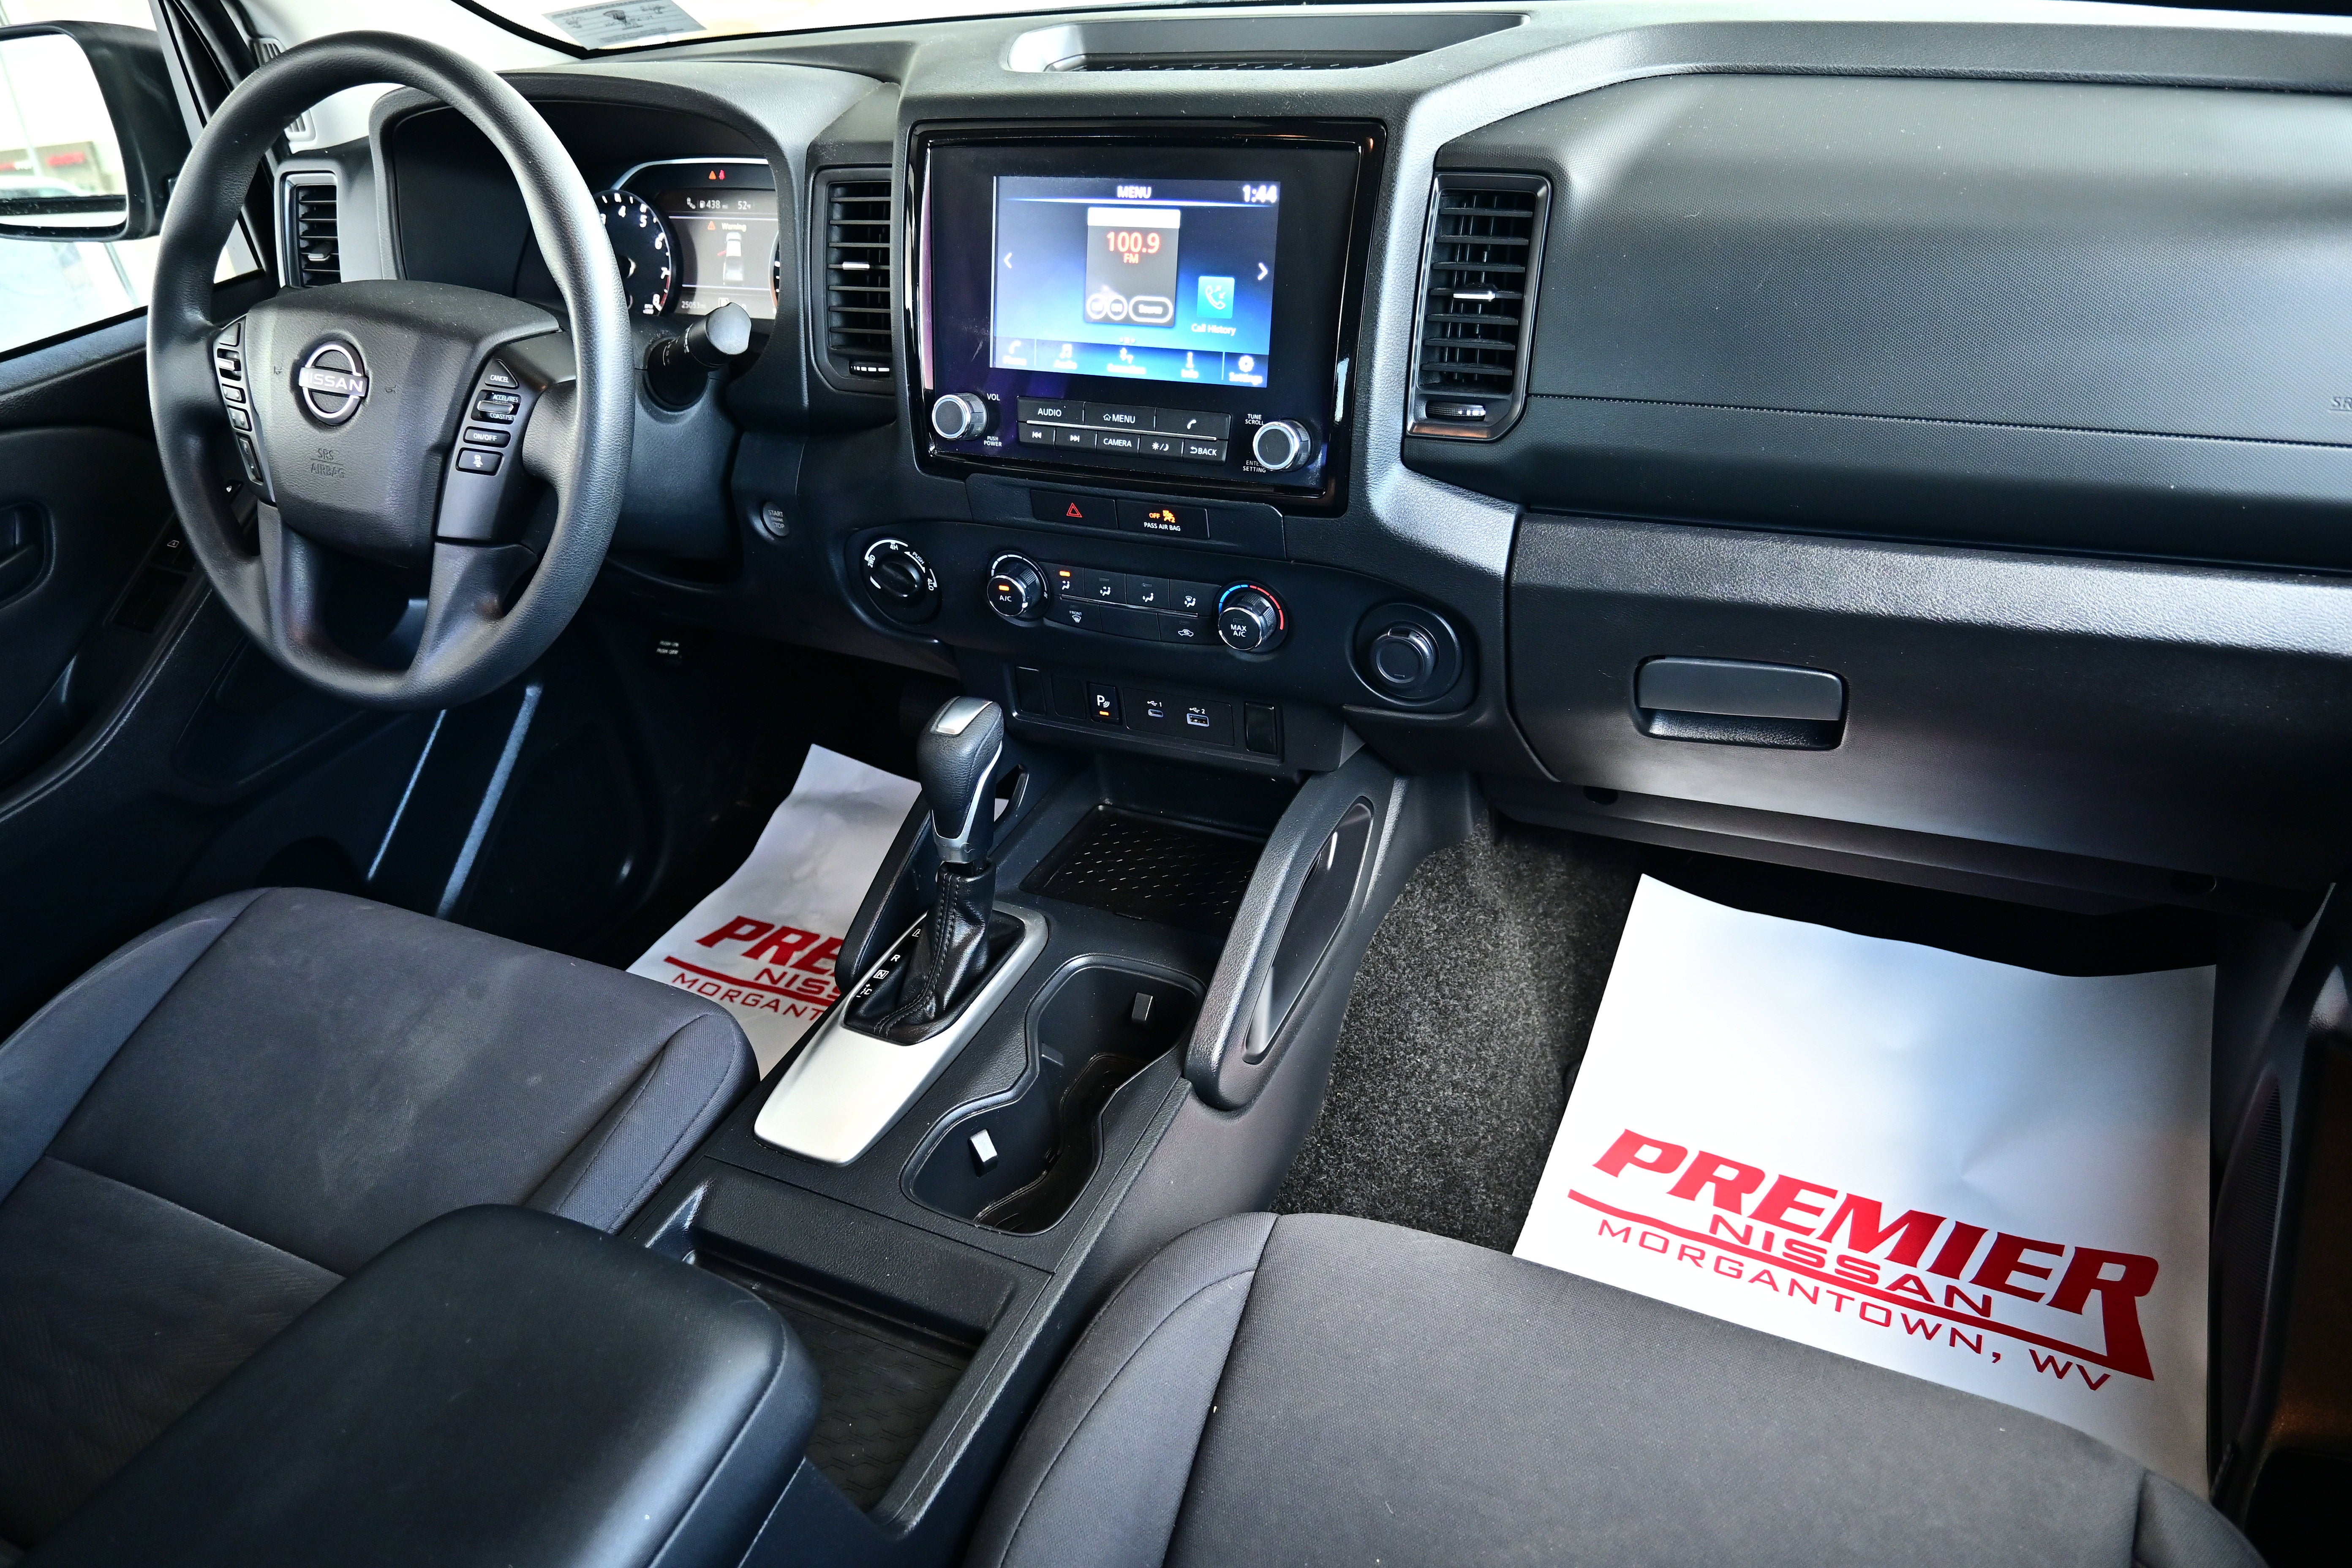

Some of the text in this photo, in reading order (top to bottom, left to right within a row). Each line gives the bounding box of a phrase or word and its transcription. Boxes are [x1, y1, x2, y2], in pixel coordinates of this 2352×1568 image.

[1116, 185, 1152, 199] MENU
[1242, 184, 1278, 203] 1:44
[706, 200, 721, 209] 438
[618, 205, 626, 218] 4
[639, 214, 648, 228] 5
[721, 222, 747, 232] Warning
[654, 237, 663, 250] 6
[1106, 231, 1160, 254] 100.9
[1123, 253, 1139, 264] FM
[660, 267, 667, 280] 7
[1191, 323, 1237, 337] Call History
[490, 374, 509, 383] CANCEL
[493, 394, 519, 403] ACCEL/RES
[986, 393, 1001, 401] VOL
[490, 412, 516, 421] COAST/SET
[1037, 408, 1062, 417] AUDIO
[1112, 414, 1135, 424] MENU
[473, 433, 498, 441] ON/OFF
[1103, 438, 1132, 448] CAMERA
[318, 448, 335, 460] SRS
[1198, 447, 1217, 456] BACK
[310, 463, 346, 478] AIRBAG
[768, 509, 784, 517] START
[867, 554, 876, 568] 2WD
[912, 551, 925, 564] PUSH
[1230, 623, 1247, 632] MAX
[694, 915, 844, 977] PRE
[1592, 1128, 2159, 1381] PREMIER
[1708, 1213, 1993, 1318] NISSAN
[1597, 1219, 2112, 1391] MORGANTOWN, WV
